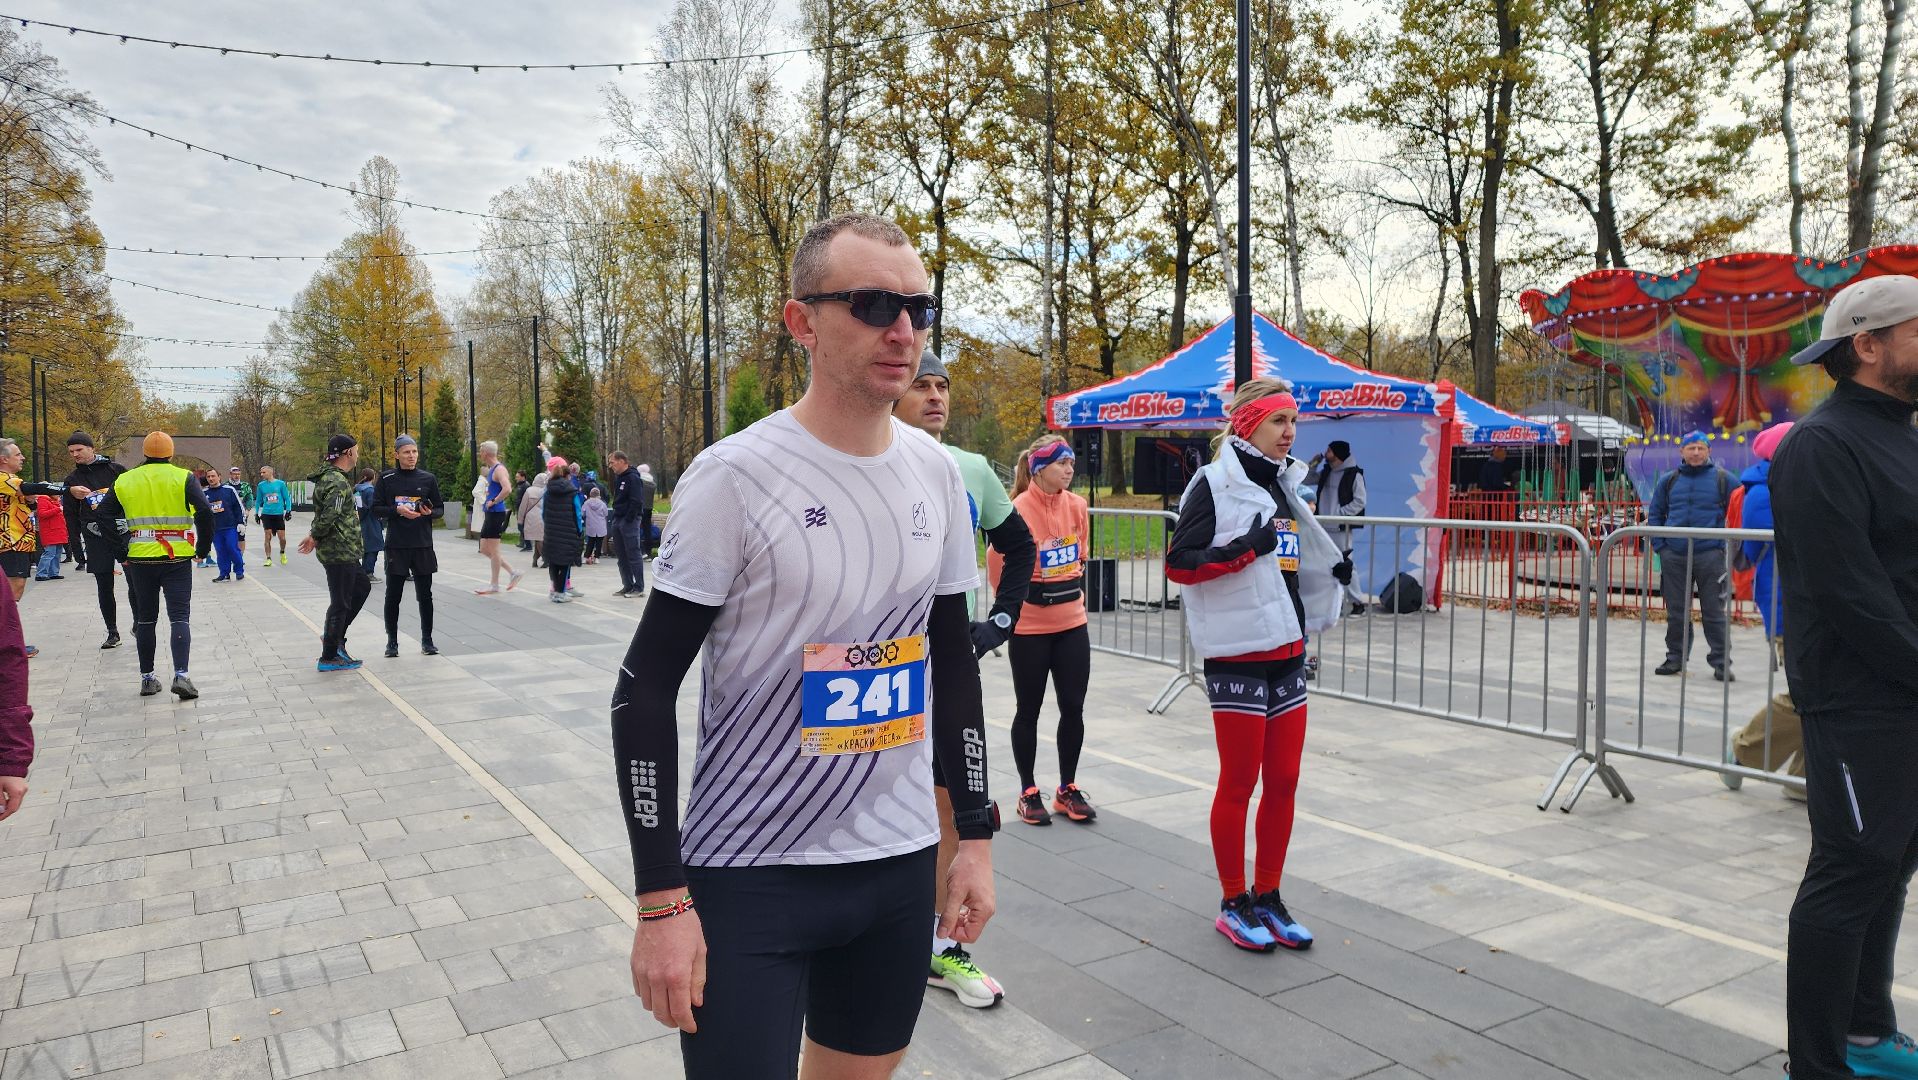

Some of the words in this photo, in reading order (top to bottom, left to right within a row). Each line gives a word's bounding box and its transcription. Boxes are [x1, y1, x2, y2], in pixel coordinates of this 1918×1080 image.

[1097, 392, 1185, 421] redBike
[1316, 383, 1406, 410] redBike
[1046, 545, 1076, 567] 235
[826, 669, 909, 720] 241
